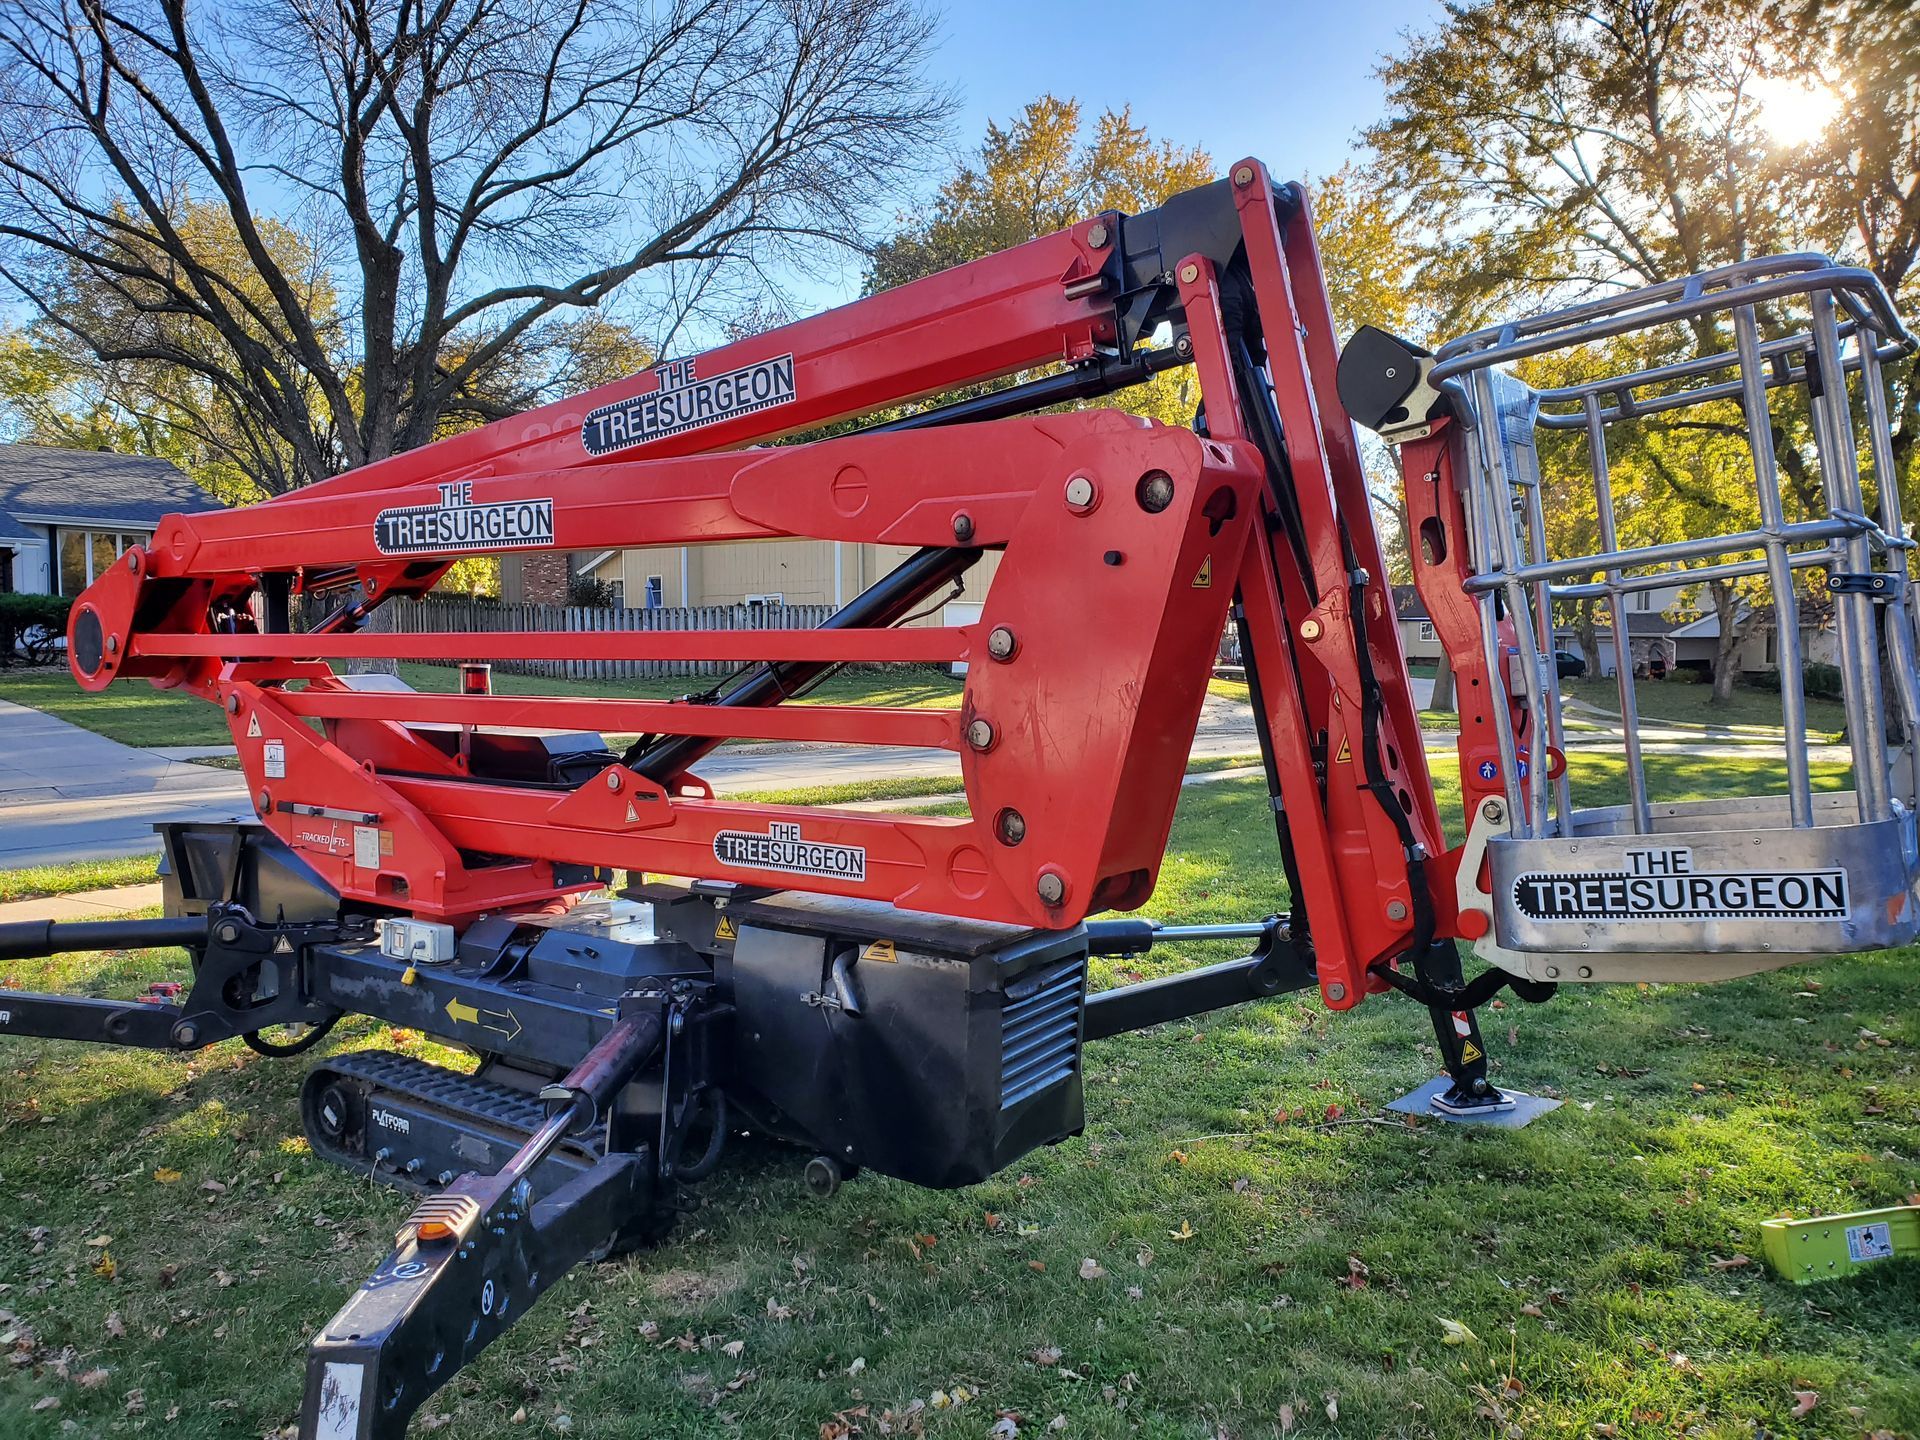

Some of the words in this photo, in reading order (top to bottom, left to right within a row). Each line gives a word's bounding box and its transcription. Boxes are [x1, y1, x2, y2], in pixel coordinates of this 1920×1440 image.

[655, 358, 697, 392] THE
[439, 482, 472, 508] THE
[302, 832, 330, 844] TRACKED
[771, 824, 798, 841] THE
[1627, 850, 1689, 875] THE
